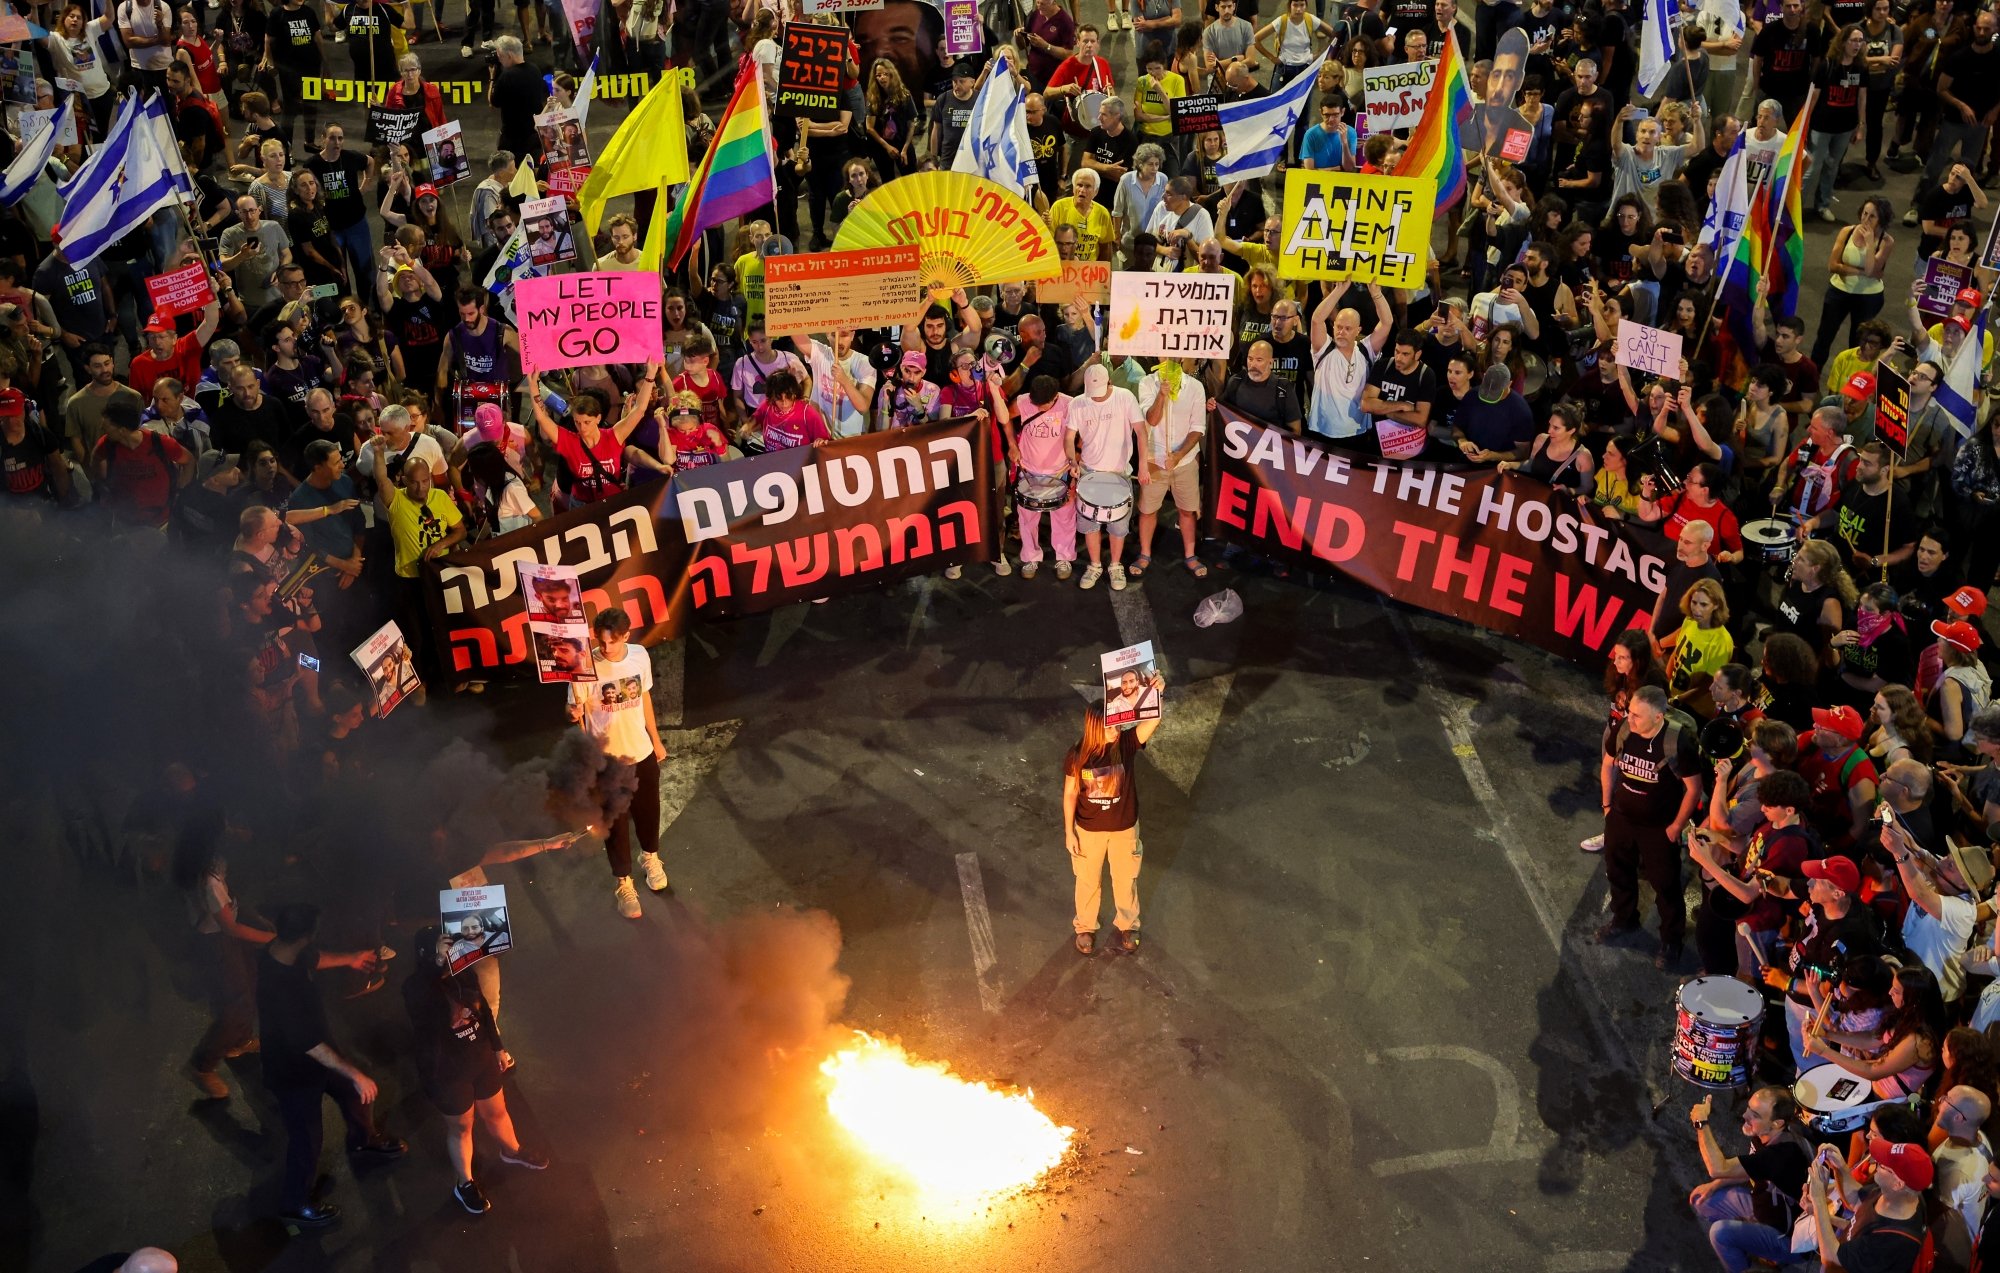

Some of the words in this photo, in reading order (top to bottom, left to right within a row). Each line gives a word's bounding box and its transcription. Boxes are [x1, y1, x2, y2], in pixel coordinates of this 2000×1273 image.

[290, 28, 311, 36] PEOPLE
[788, 33, 844, 61] ביבי
[661, 68, 697, 91] 8
[785, 61, 840, 87] בוגד
[1366, 61, 1430, 91] להפקרה
[302, 77, 397, 108] קופים
[429, 81, 482, 104] יהי
[1177, 97, 1217, 107] החטופים
[1189, 105, 1217, 114] הביתה
[336, 170, 345, 180] MY
[888, 207, 970, 245] בוערת
[972, 187, 1048, 262] אדמתי
[1283, 198, 1416, 264] ALL
[1302, 217, 1395, 246] THEM
[809, 260, 826, 271] זול
[830, 259, 849, 270] הכי
[862, 255, 892, 267] בעזה
[894, 252, 915, 263] בית
[1301, 249, 1409, 282] HME!
[151, 278, 169, 288] END
[170, 273, 186, 283] THE
[186, 266, 203, 279] WAR
[769, 262, 805, 276] בארץ!
[158, 293, 174, 304] ALL
[187, 283, 207, 295] THEM
[168, 280, 194, 292] BRING
[559, 277, 623, 299] LET
[1145, 280, 1230, 301] הממשלה
[173, 296, 199, 309] HOME
[528, 306, 560, 330] MY
[570, 301, 659, 323] PEOPLE
[1156, 308, 1228, 327] הורגת
[558, 327, 620, 358] GO
[1161, 333, 1225, 351] אותנו
[1640, 326, 1658, 343] 58
[1627, 338, 1671, 360] CAN'T
[1628, 352, 1667, 374] WAIT
[677, 435, 974, 544] החטופים
[1223, 421, 1352, 486] SAVE
[1367, 462, 1466, 516] THE
[1477, 485, 1667, 594] HOSTAG
[689, 500, 981, 609] הממשלה
[1216, 471, 1366, 562] END
[1393, 520, 1533, 617] THE
[440, 504, 658, 614] הביתה
[1618, 760, 1659, 781] בחטופים
[1623, 753, 1656, 771] בוחרים
